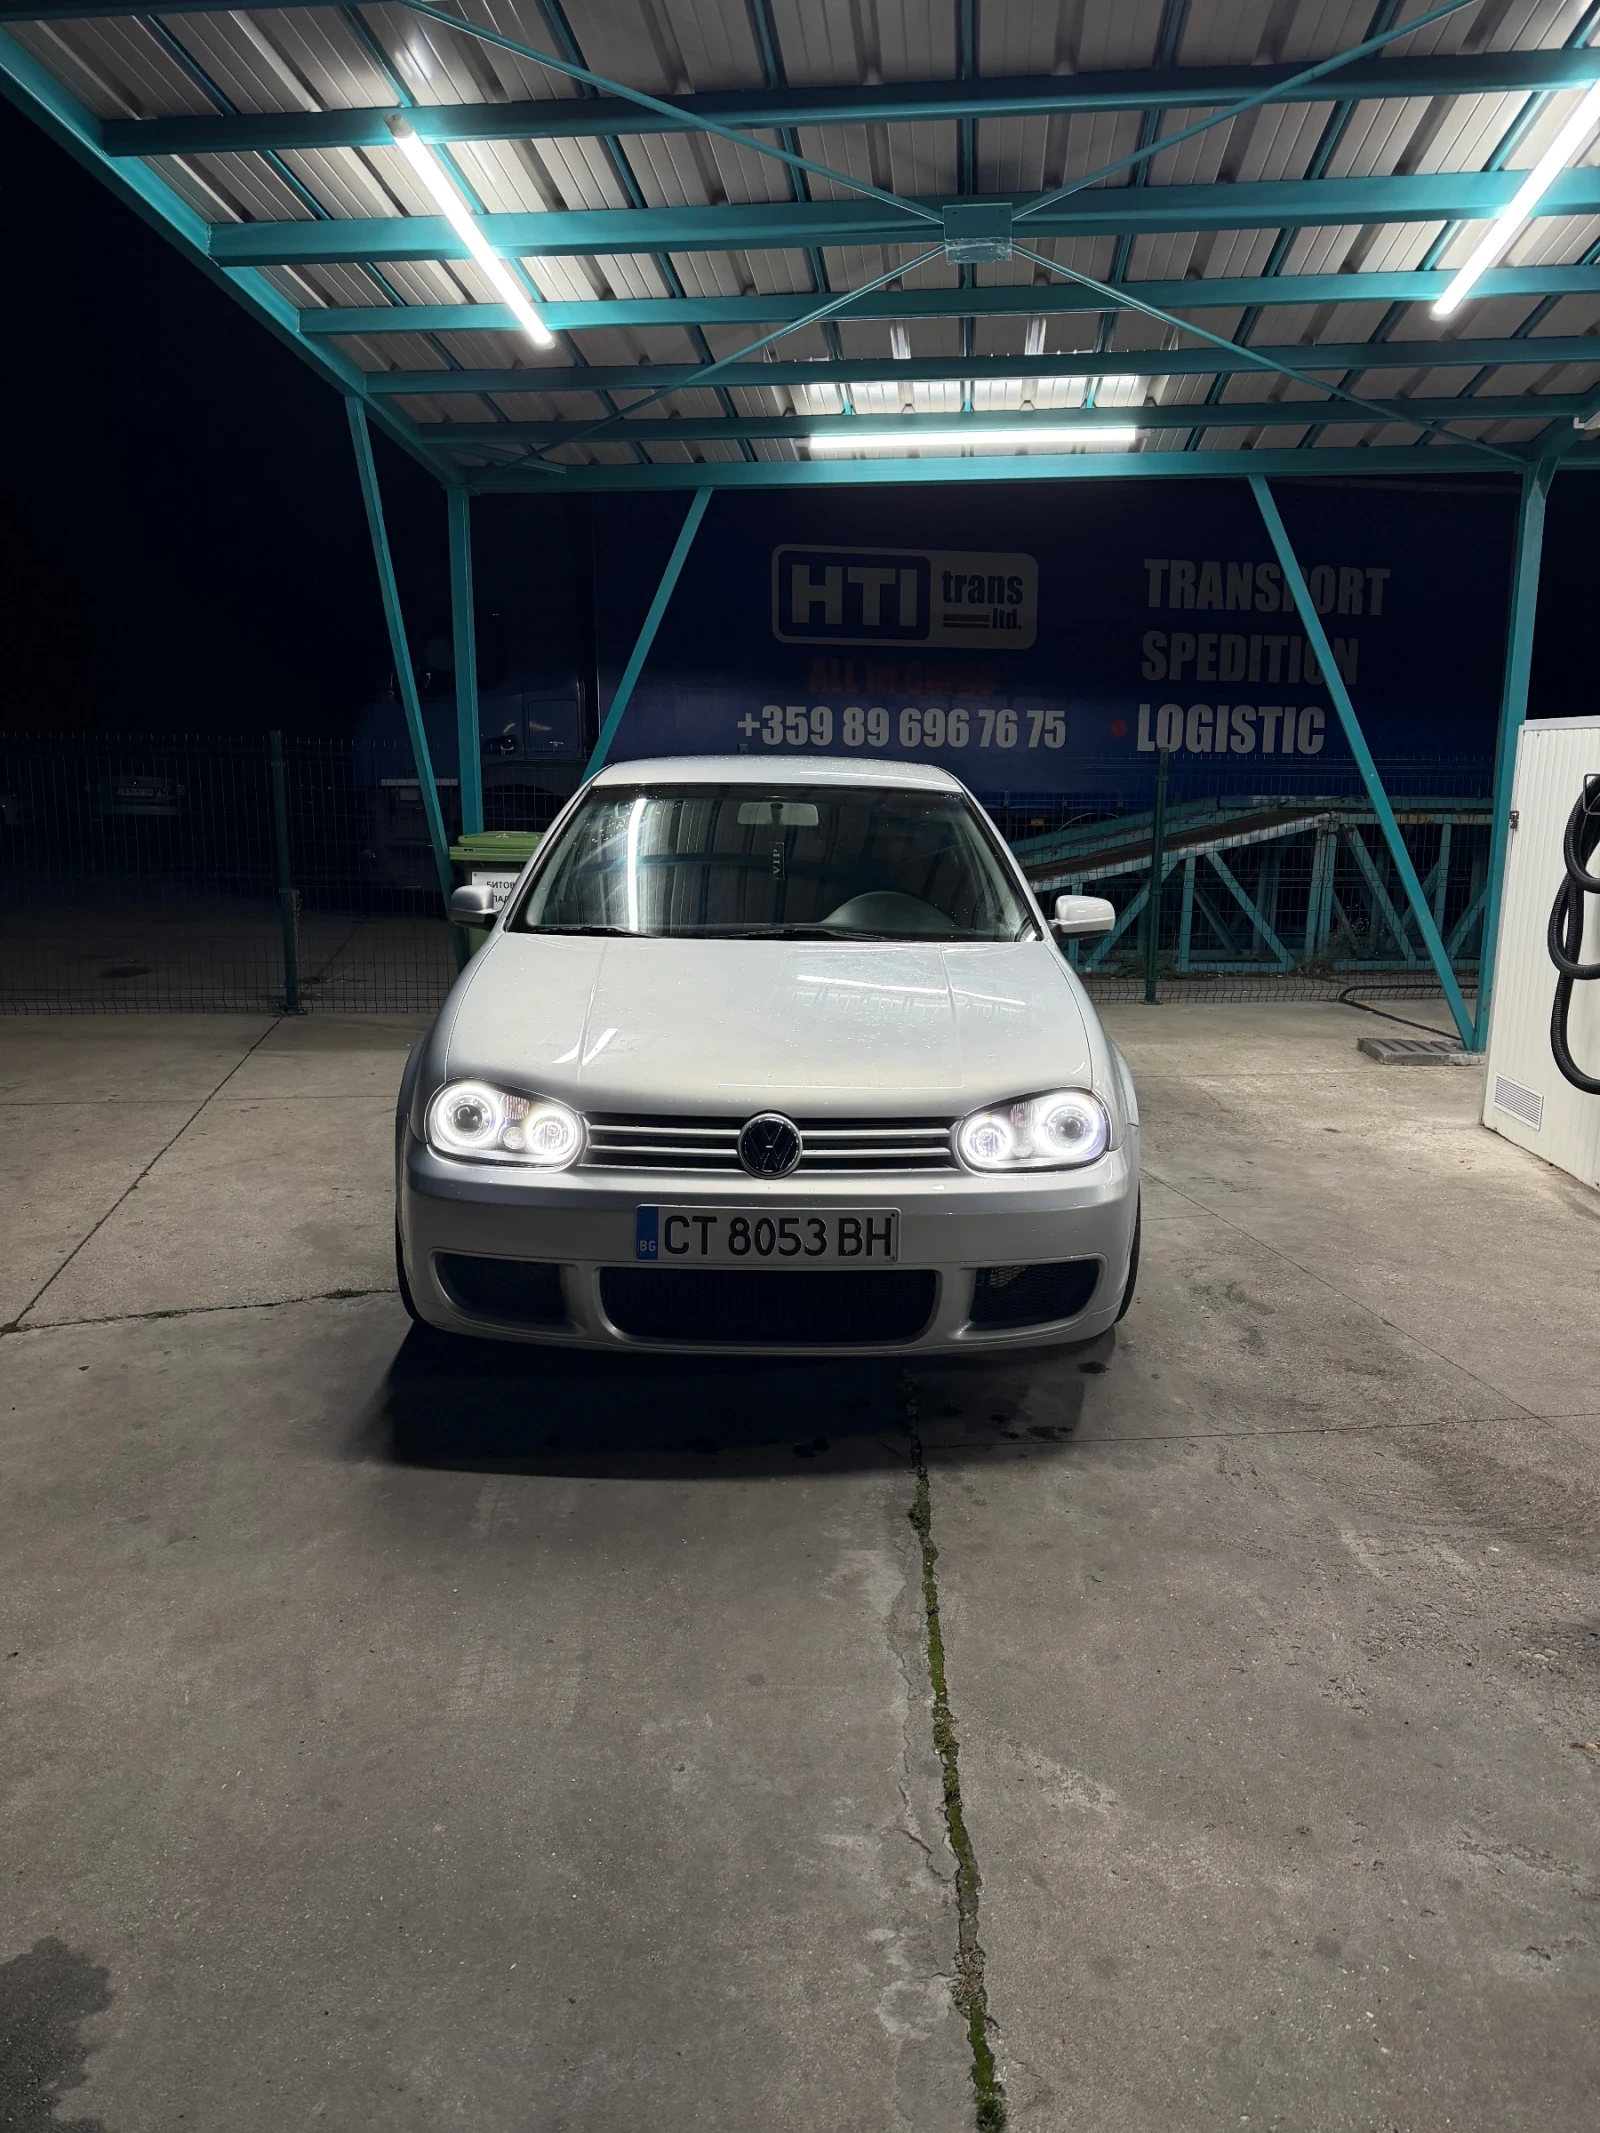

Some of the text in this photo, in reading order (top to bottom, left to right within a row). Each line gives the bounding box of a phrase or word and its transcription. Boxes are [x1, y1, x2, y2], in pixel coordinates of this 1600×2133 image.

[791, 563, 918, 628] HTI
[941, 569, 1024, 605] trans
[991, 607, 1022, 631] ltd.
[737, 704, 1066, 749] +359 89 696 76 75
[1136, 703, 1326, 755] LOGISTIC
[640, 1240, 656, 1251] BG
[664, 1215, 892, 1257] CT 8053 BH
